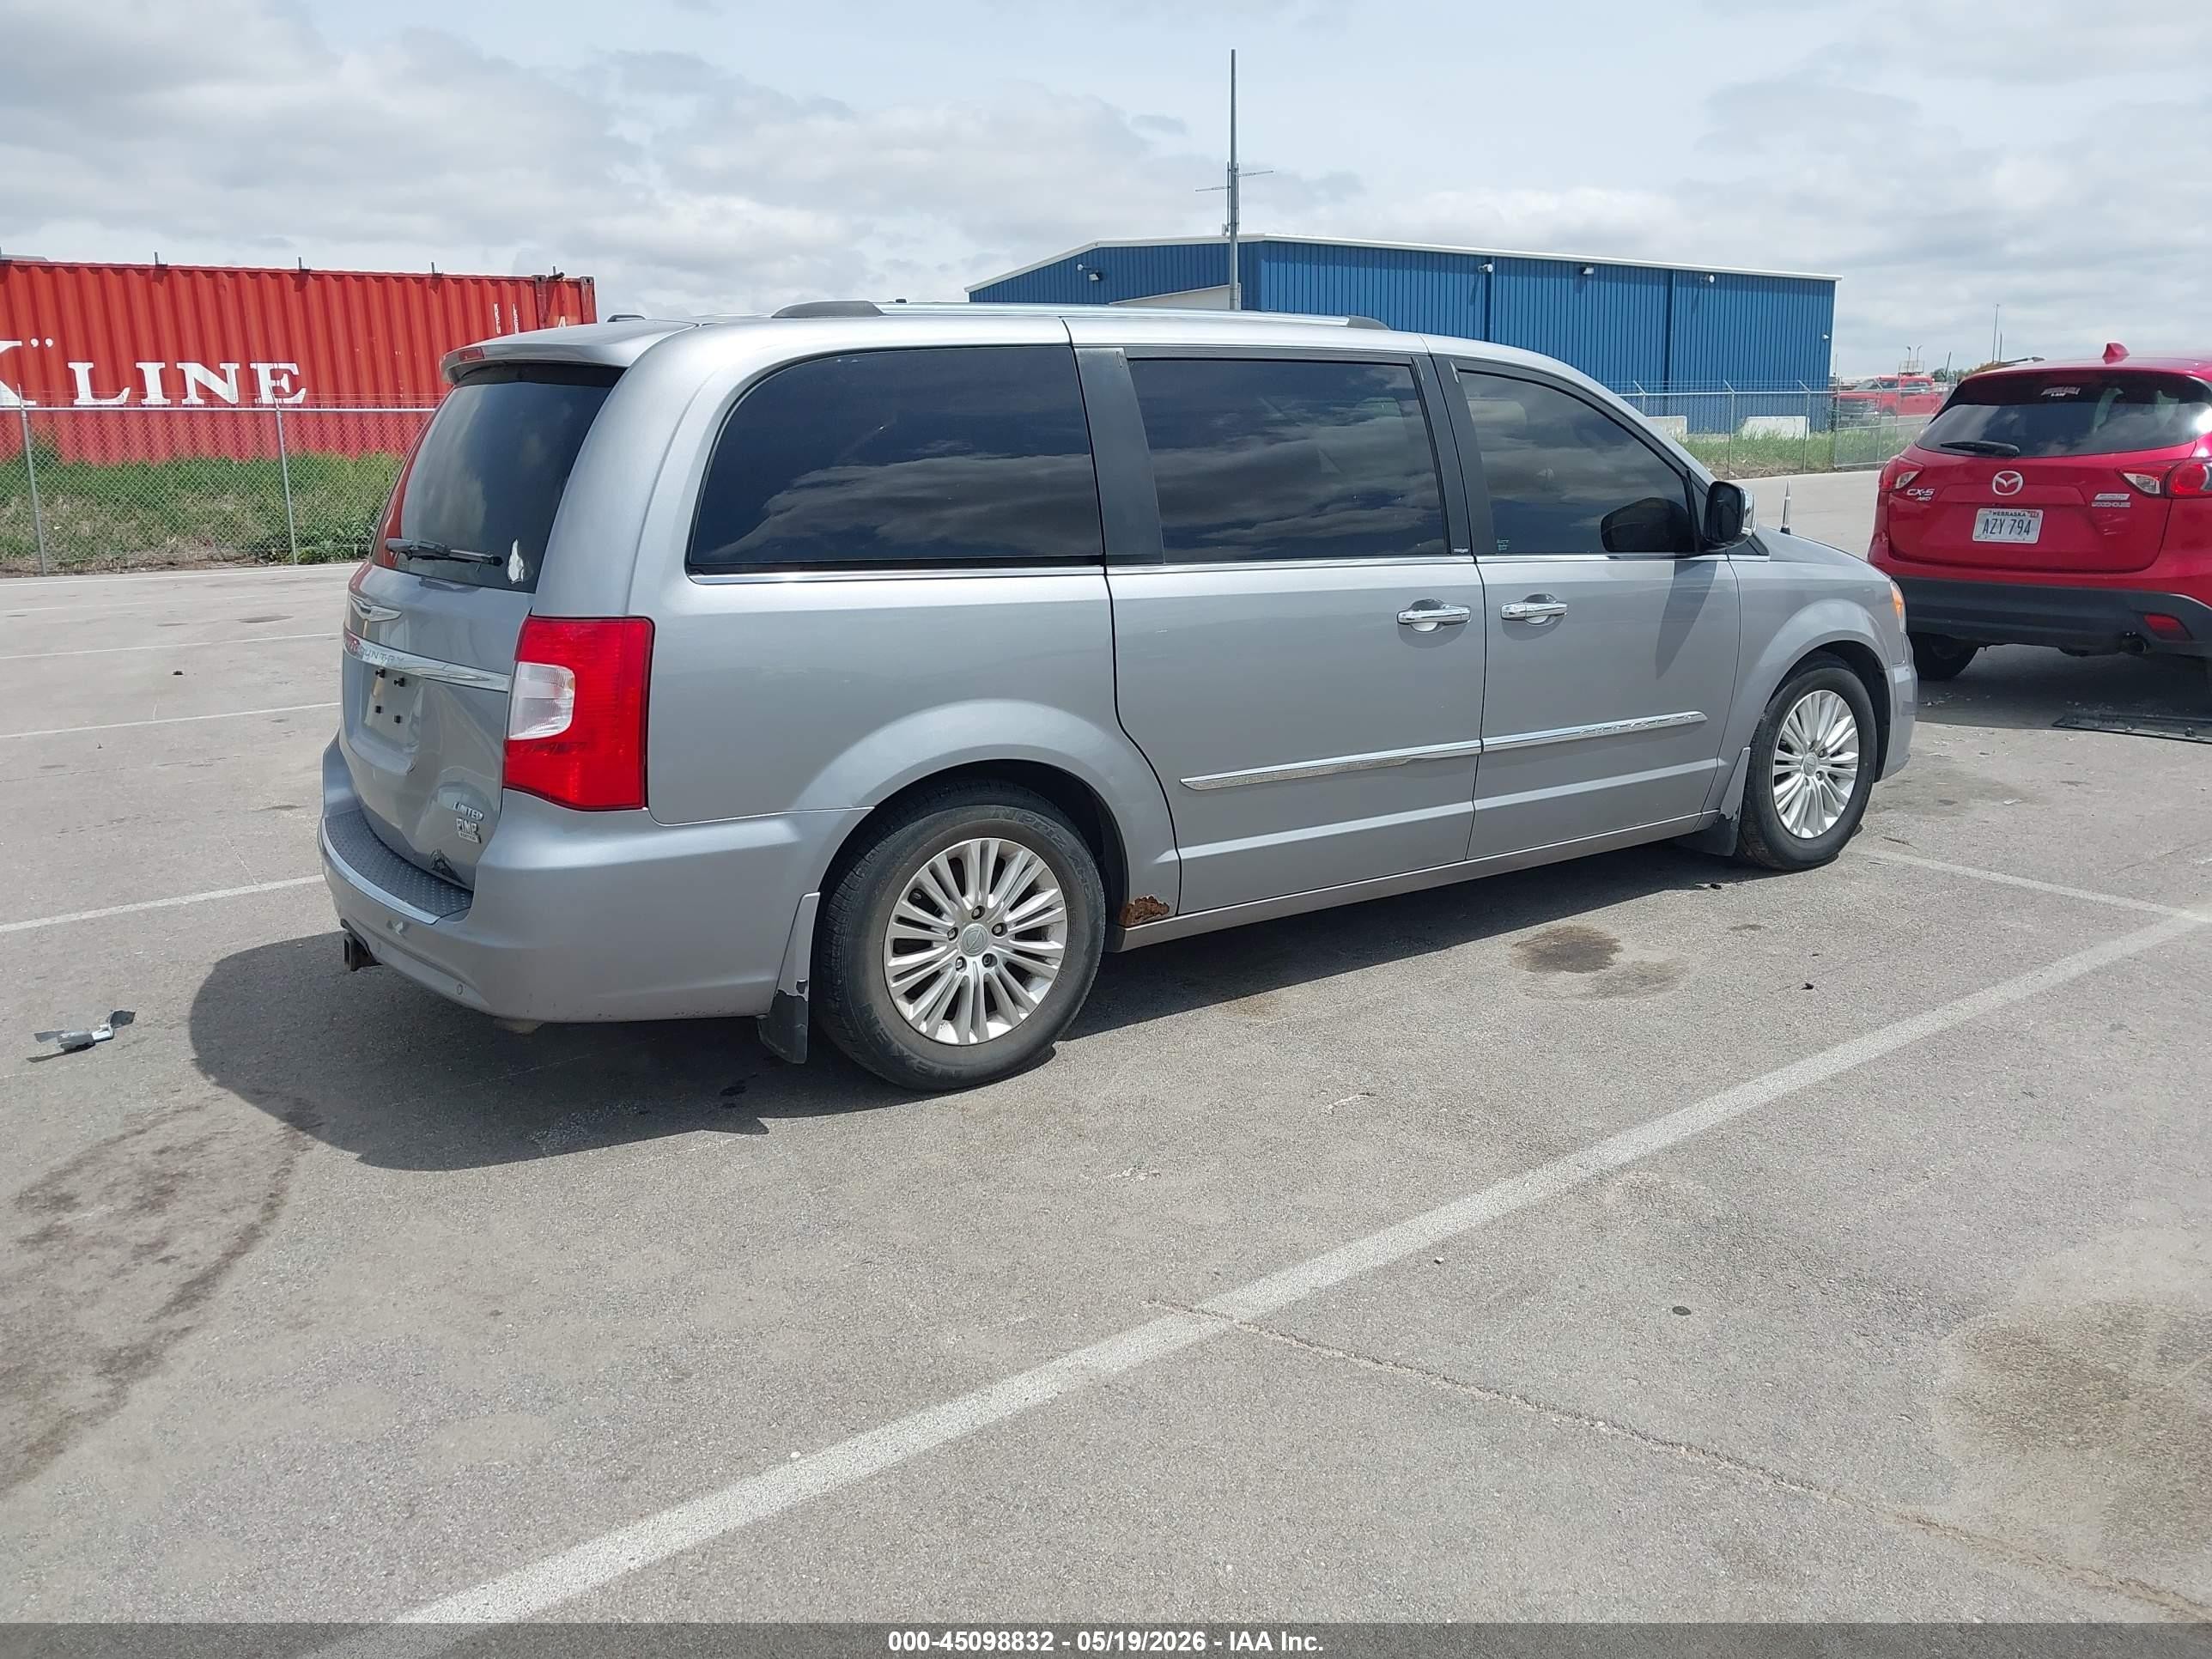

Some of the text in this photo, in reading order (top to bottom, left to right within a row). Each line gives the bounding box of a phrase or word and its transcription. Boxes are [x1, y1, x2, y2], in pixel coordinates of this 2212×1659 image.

[68, 362, 306, 405] LINE
[1907, 488, 1935, 496] CX-5
[1982, 518, 2032, 536] AZY 794
[1580, 714, 1692, 737] CHRYSLER
[453, 802, 483, 820] LIMITED
